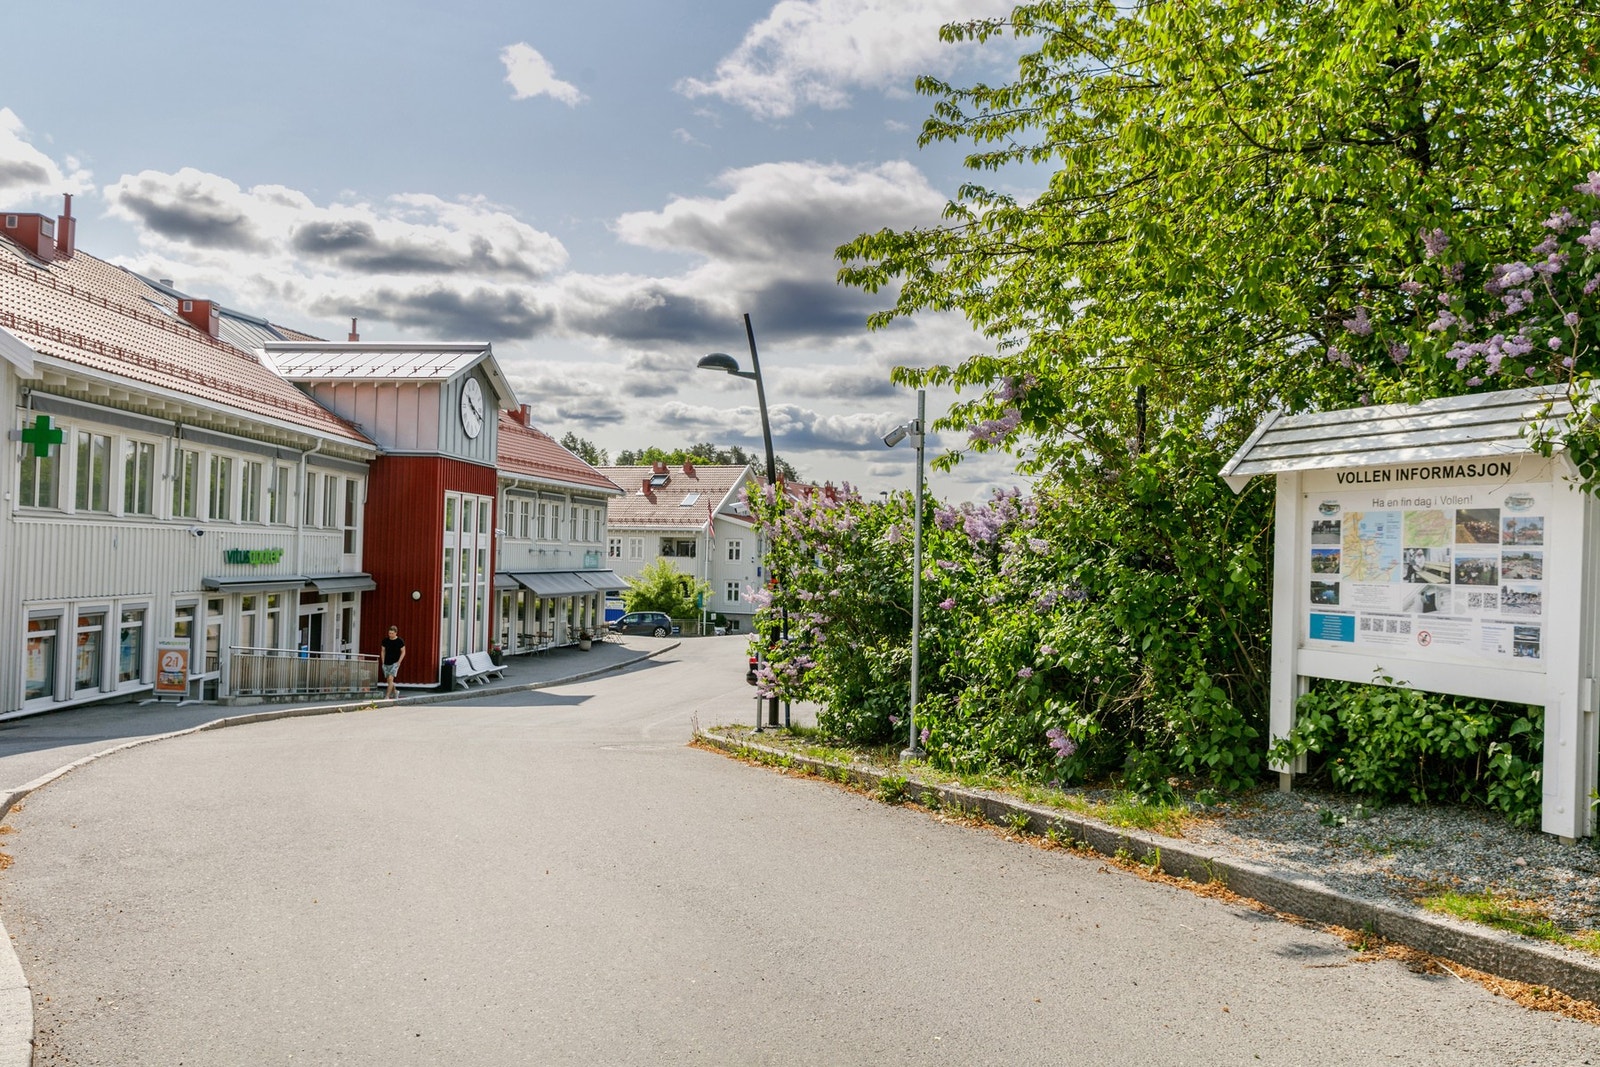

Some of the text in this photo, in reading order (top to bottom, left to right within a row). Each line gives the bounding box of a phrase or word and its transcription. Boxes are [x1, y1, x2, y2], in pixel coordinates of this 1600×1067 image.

[1337, 462, 1511, 484] VOLLEN INFORMASJON
[1373, 495, 1473, 509] Ha en fin dag i Vollen!
